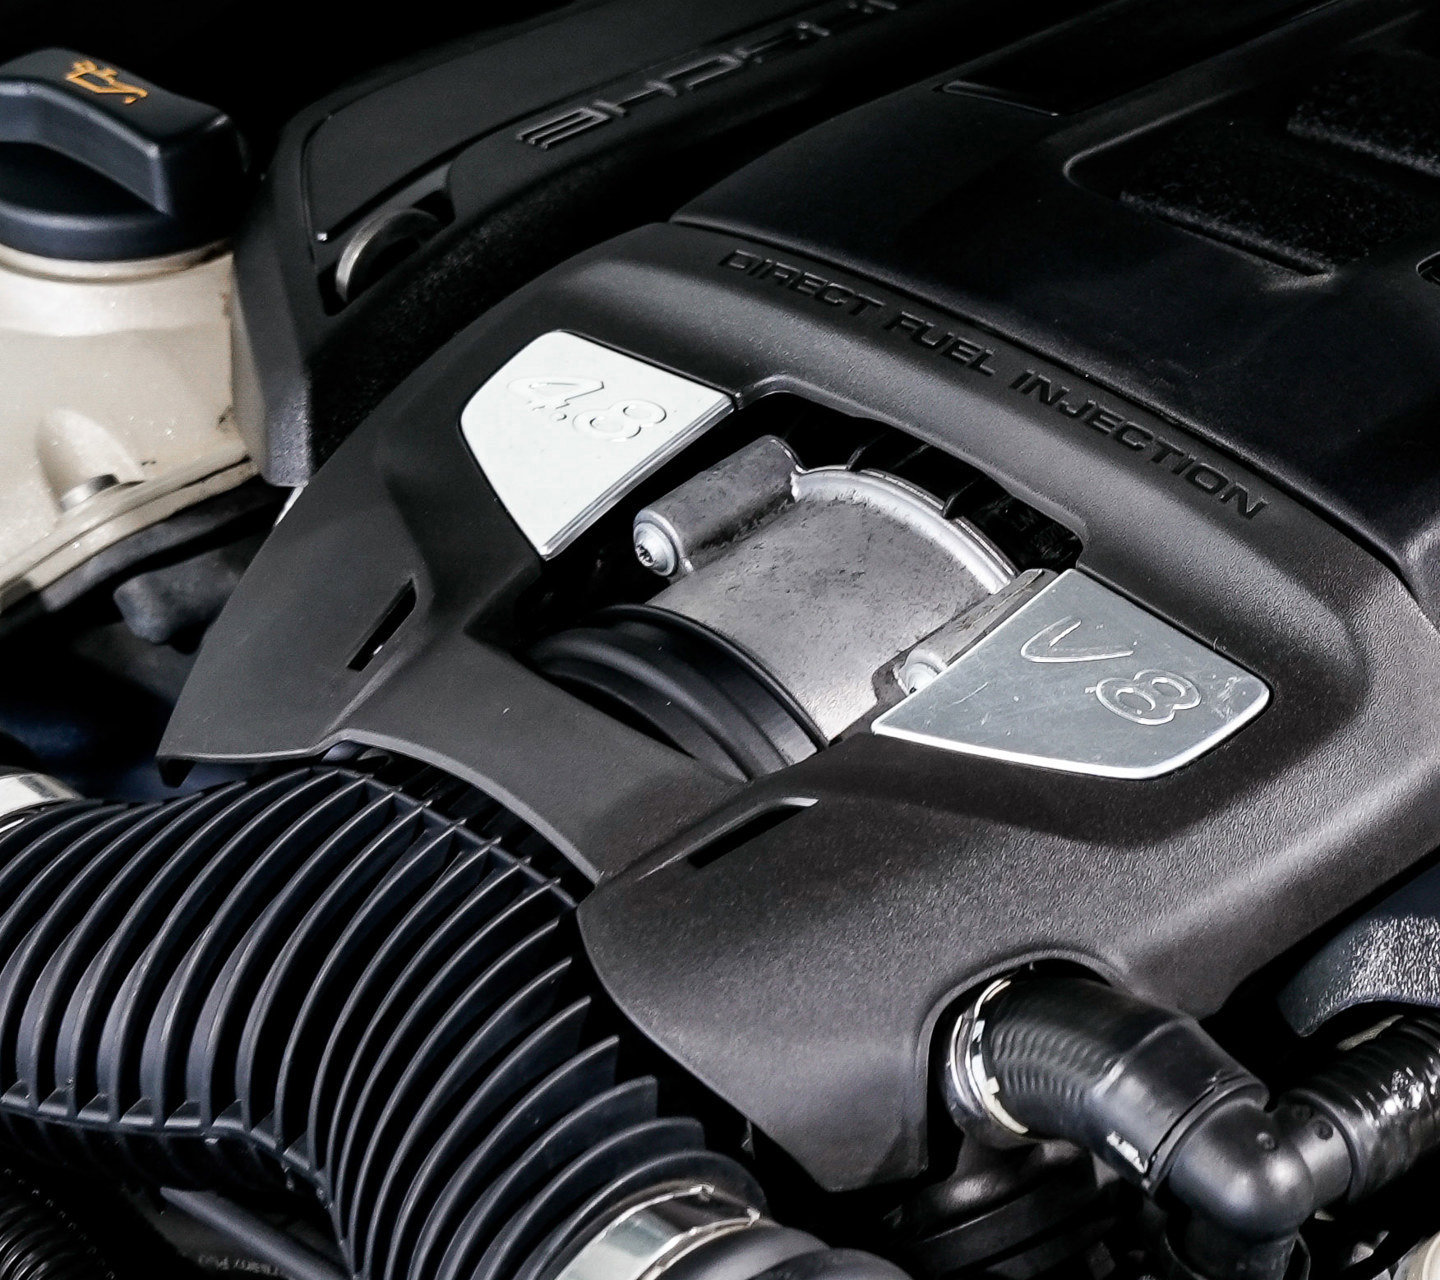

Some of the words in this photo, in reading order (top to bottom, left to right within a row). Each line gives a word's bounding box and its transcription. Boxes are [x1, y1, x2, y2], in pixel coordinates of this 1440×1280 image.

[506, 375, 668, 443] 4.8
[718, 248, 887, 316] DIRECT
[885, 310, 997, 376] FUEL
[1010, 368, 1272, 521] INJECTION
